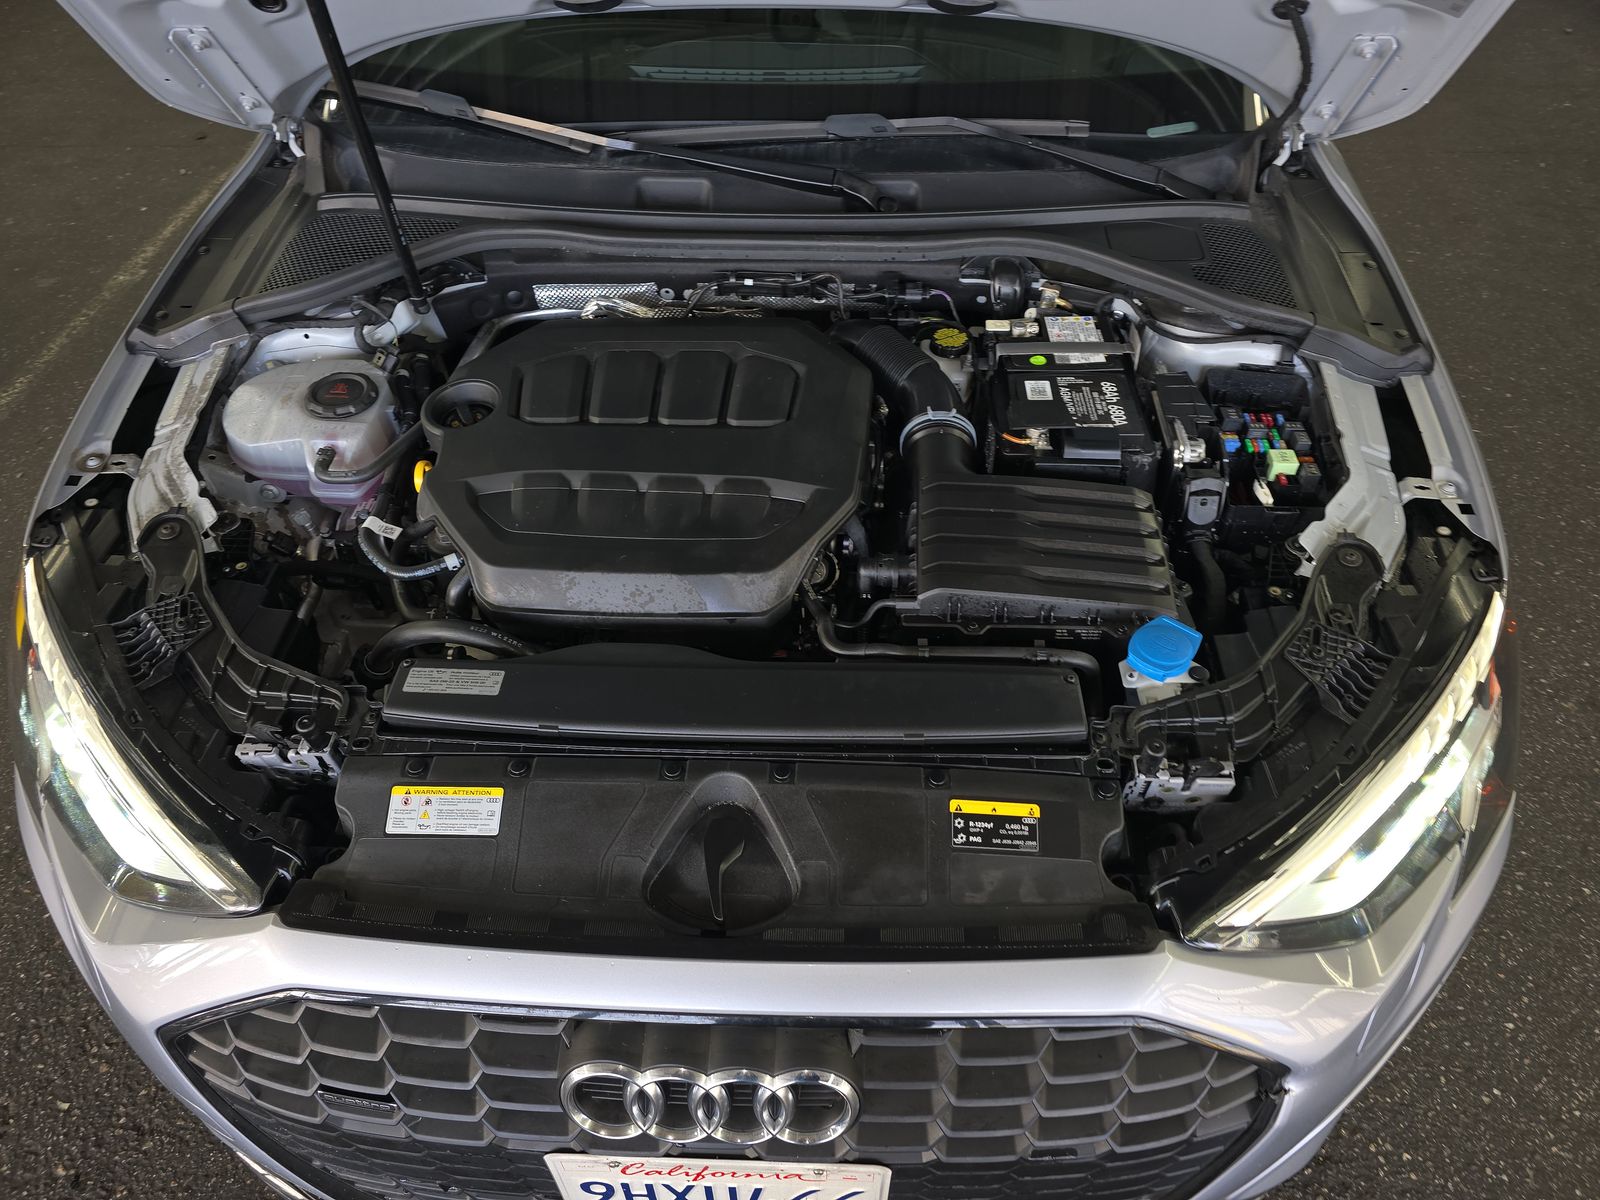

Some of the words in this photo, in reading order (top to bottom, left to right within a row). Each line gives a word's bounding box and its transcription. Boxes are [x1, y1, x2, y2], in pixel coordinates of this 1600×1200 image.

[1100, 381, 1120, 403] 68Ah
[1107, 404, 1128, 426] 680A
[969, 820, 994, 829] R-1234yf
[969, 835, 982, 843] PAG
[323, 1093, 392, 1113] quattro
[620, 1161, 826, 1182] California
